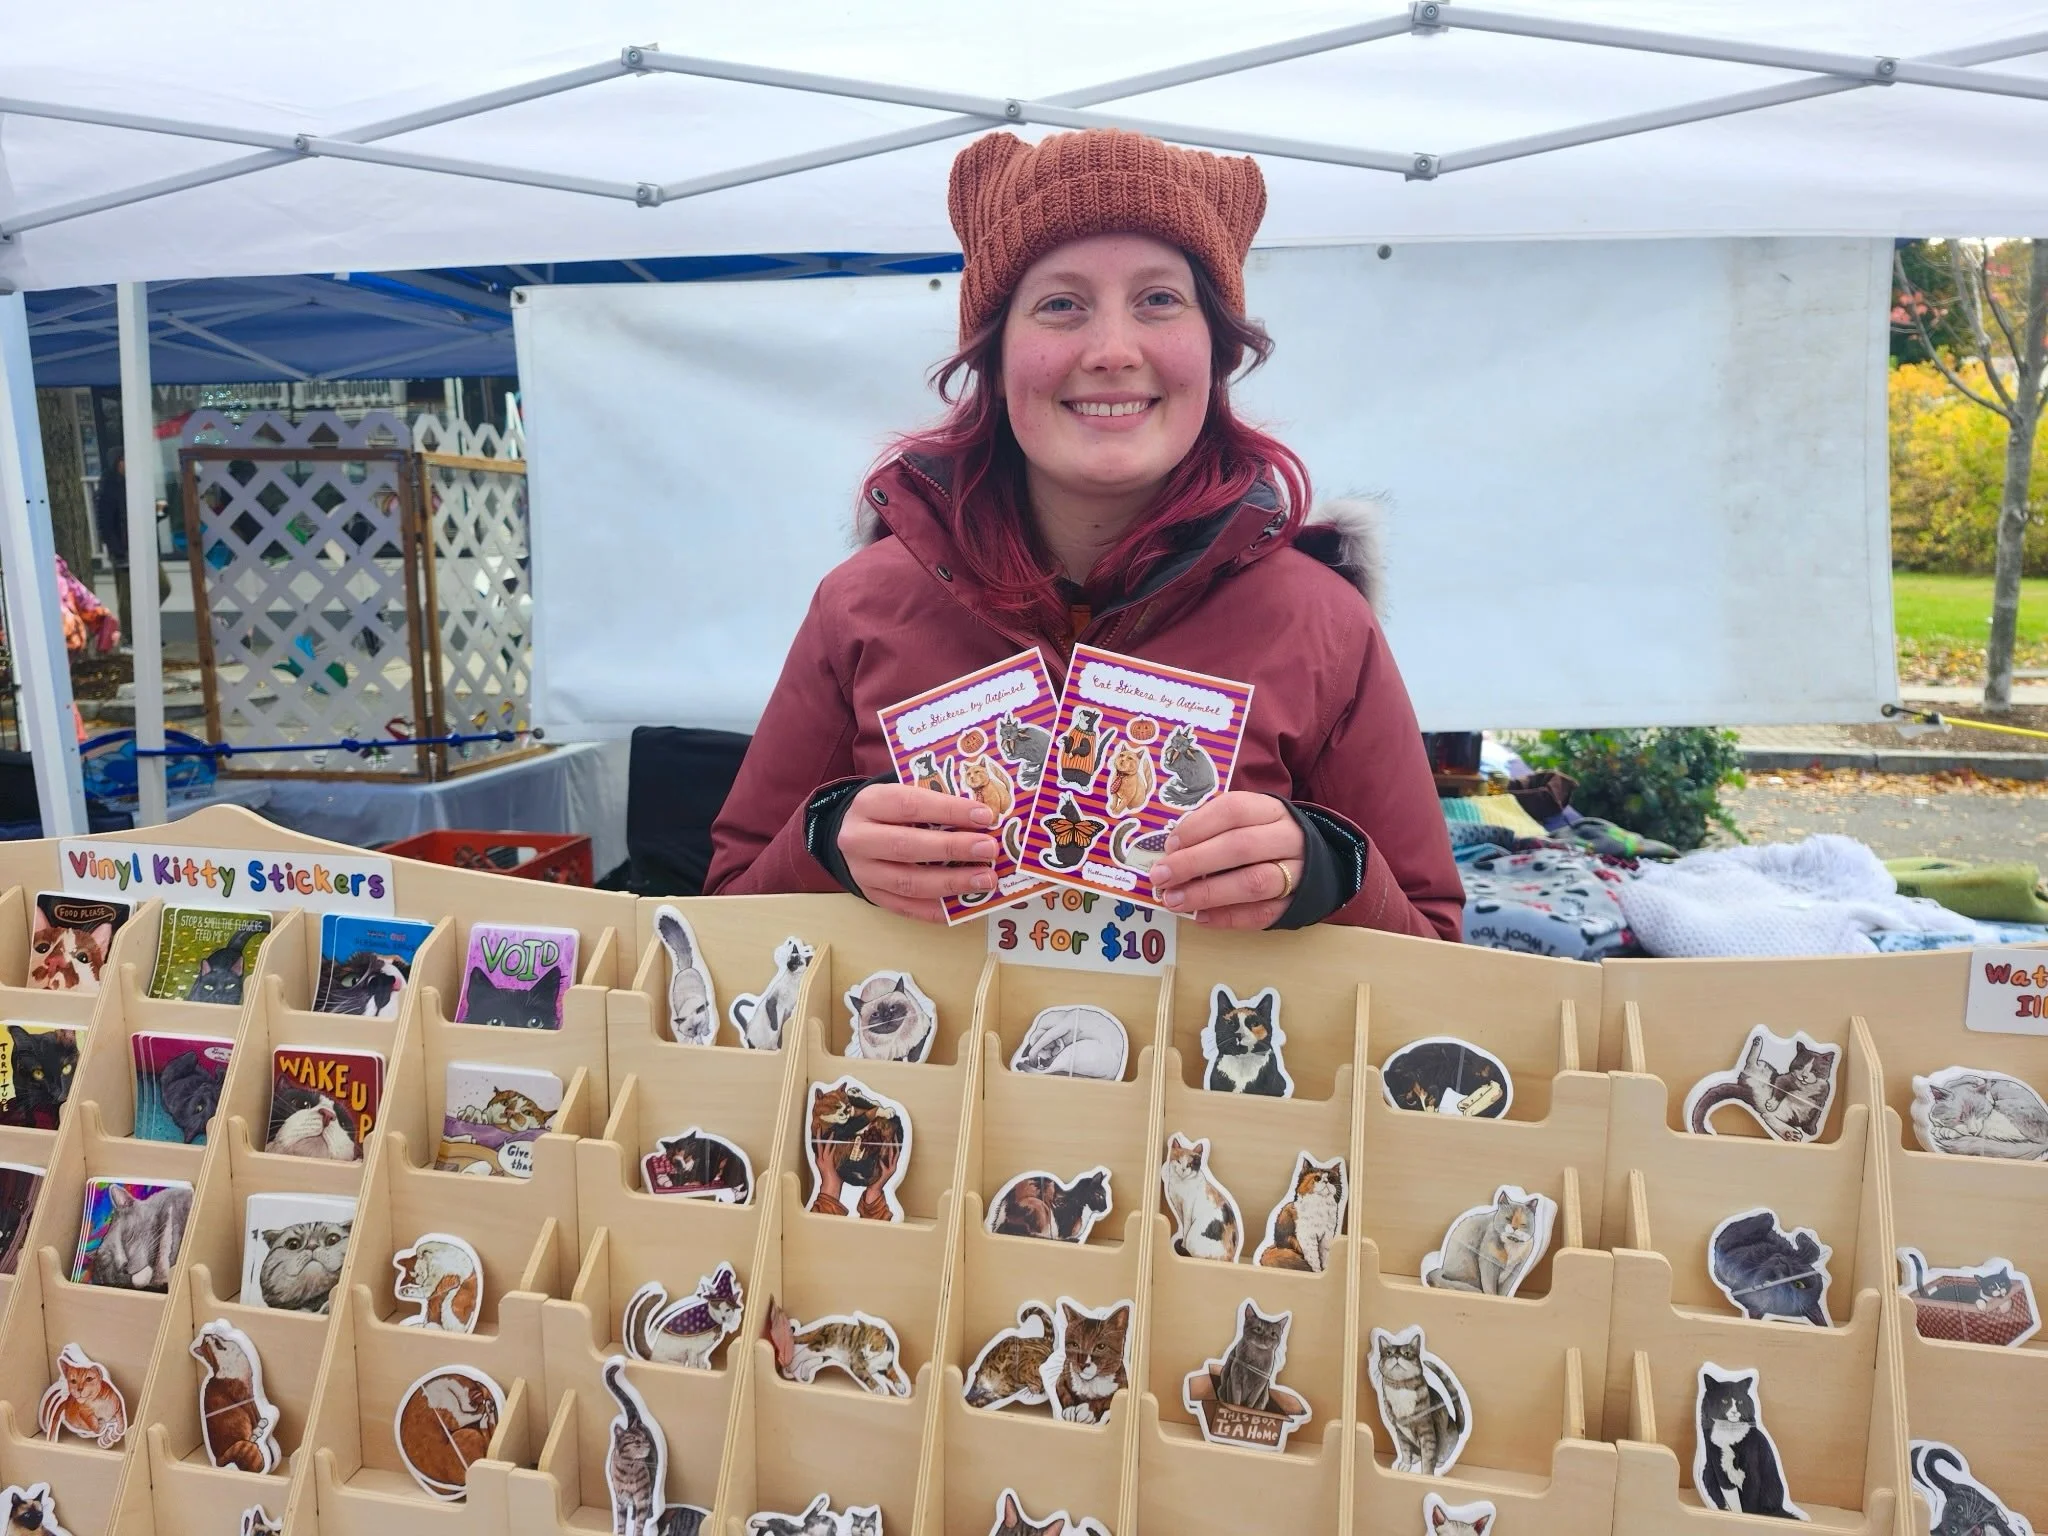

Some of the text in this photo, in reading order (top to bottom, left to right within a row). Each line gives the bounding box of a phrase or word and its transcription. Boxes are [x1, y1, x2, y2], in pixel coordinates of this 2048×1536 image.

[1093, 674, 1112, 690] Cat
[1114, 679, 1155, 701] Stickers
[1160, 694, 1175, 709] by
[908, 720, 928, 735] Cat
[929, 709, 968, 729] Stickers
[970, 700, 983, 713] by
[68, 850, 385, 899] Vinyl Kitty Stickers
[59, 907, 105, 918] FOOD PLEASE
[181, 915, 198, 928] STOP
[235, 919, 263, 932] FLOWERS
[195, 929, 224, 942] FEED ME
[997, 918, 1166, 965] 3 for $10
[481, 935, 559, 981] VOID
[1985, 963, 2048, 988] Wat
[0, 1043, 9, 1112] TORTITUDE
[280, 1056, 349, 1098] WAKE
[507, 1145, 528, 1158] Give
[1219, 1408, 1276, 1426] THIS BOX
[1232, 1424, 1244, 1437] A
